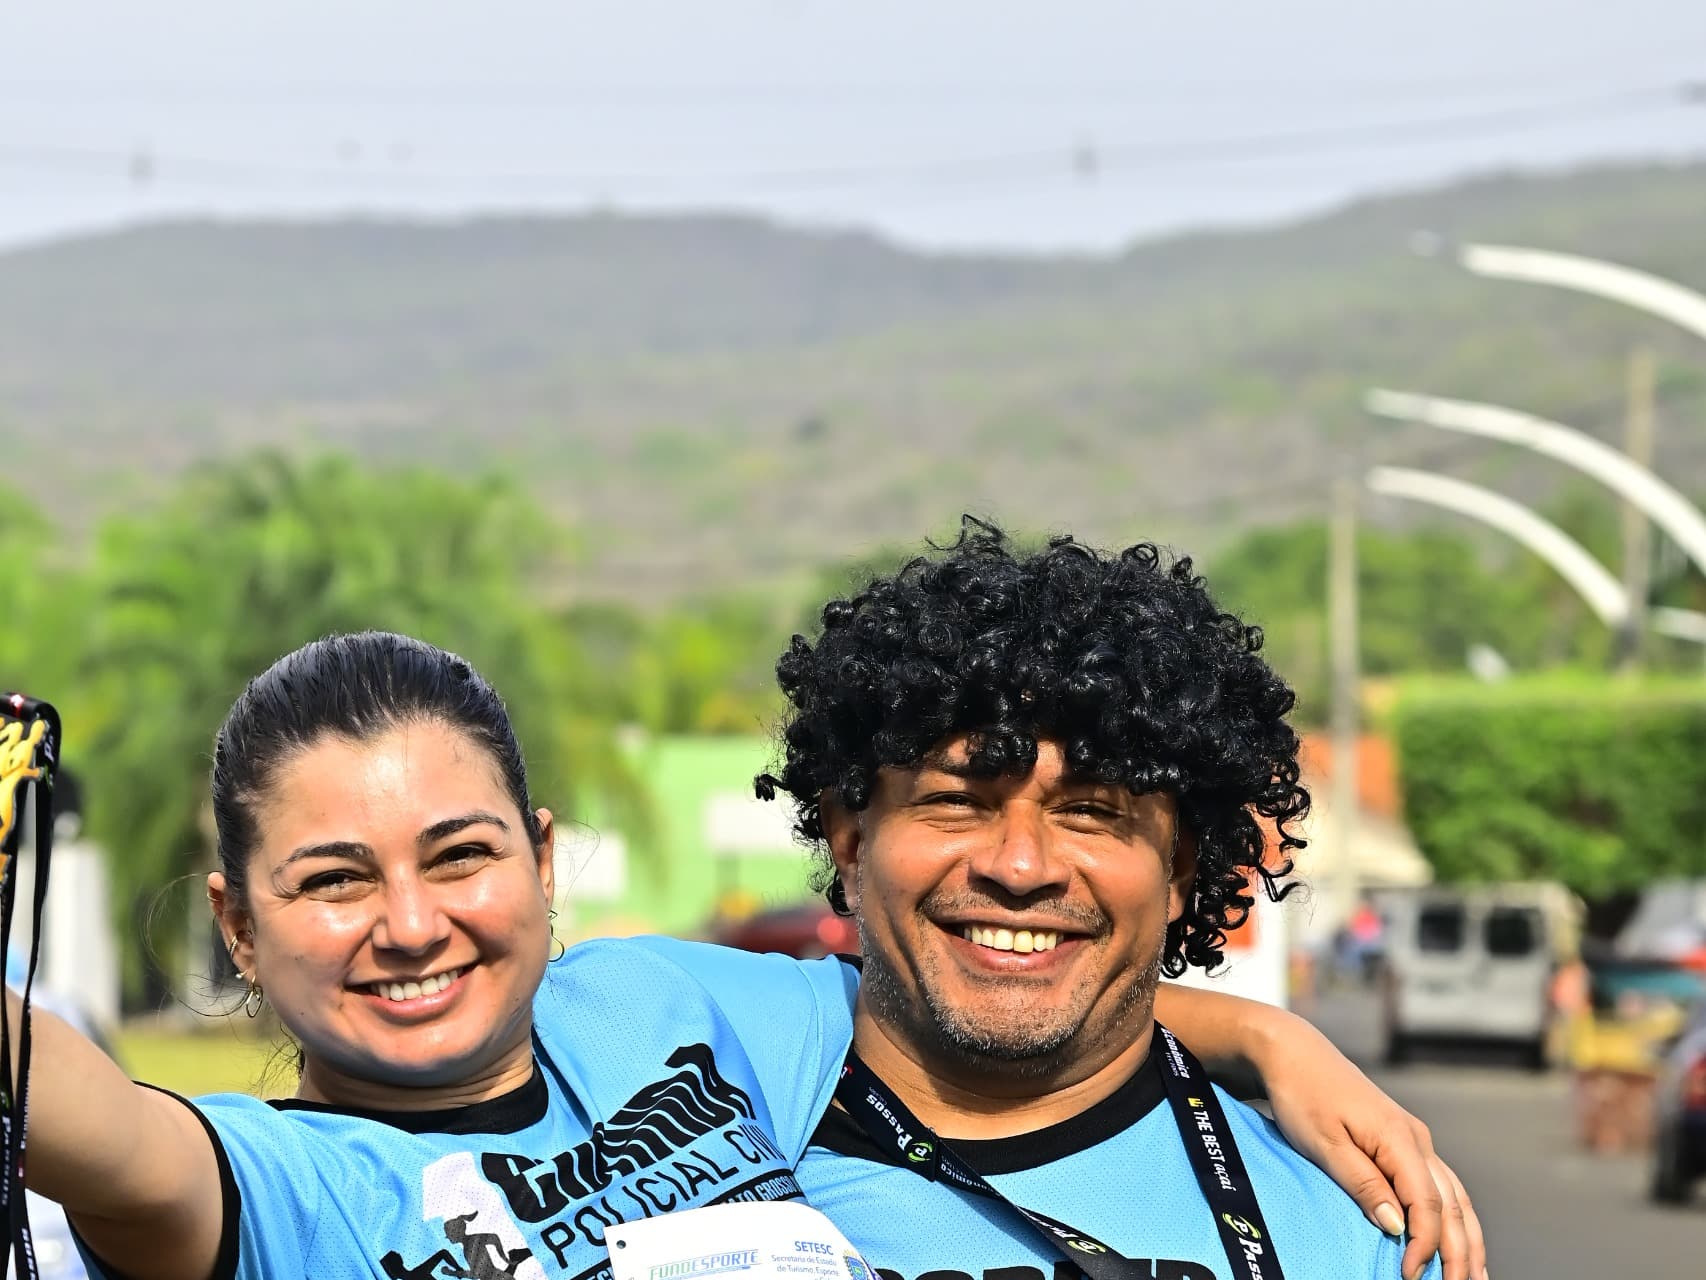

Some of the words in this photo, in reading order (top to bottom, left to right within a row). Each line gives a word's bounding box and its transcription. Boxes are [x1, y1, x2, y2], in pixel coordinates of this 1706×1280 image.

[1193, 1111, 1214, 1132] THE
[1202, 1134, 1226, 1163] BEST
[794, 1240, 834, 1256] SETESC
[650, 1251, 759, 1280] FUNDESPORTE
[771, 1254, 806, 1263] Secretaria
[806, 1255, 815, 1264] de
[816, 1257, 837, 1267] Estado
[777, 1265, 787, 1273] de
[816, 1267, 840, 1277] Esporte
